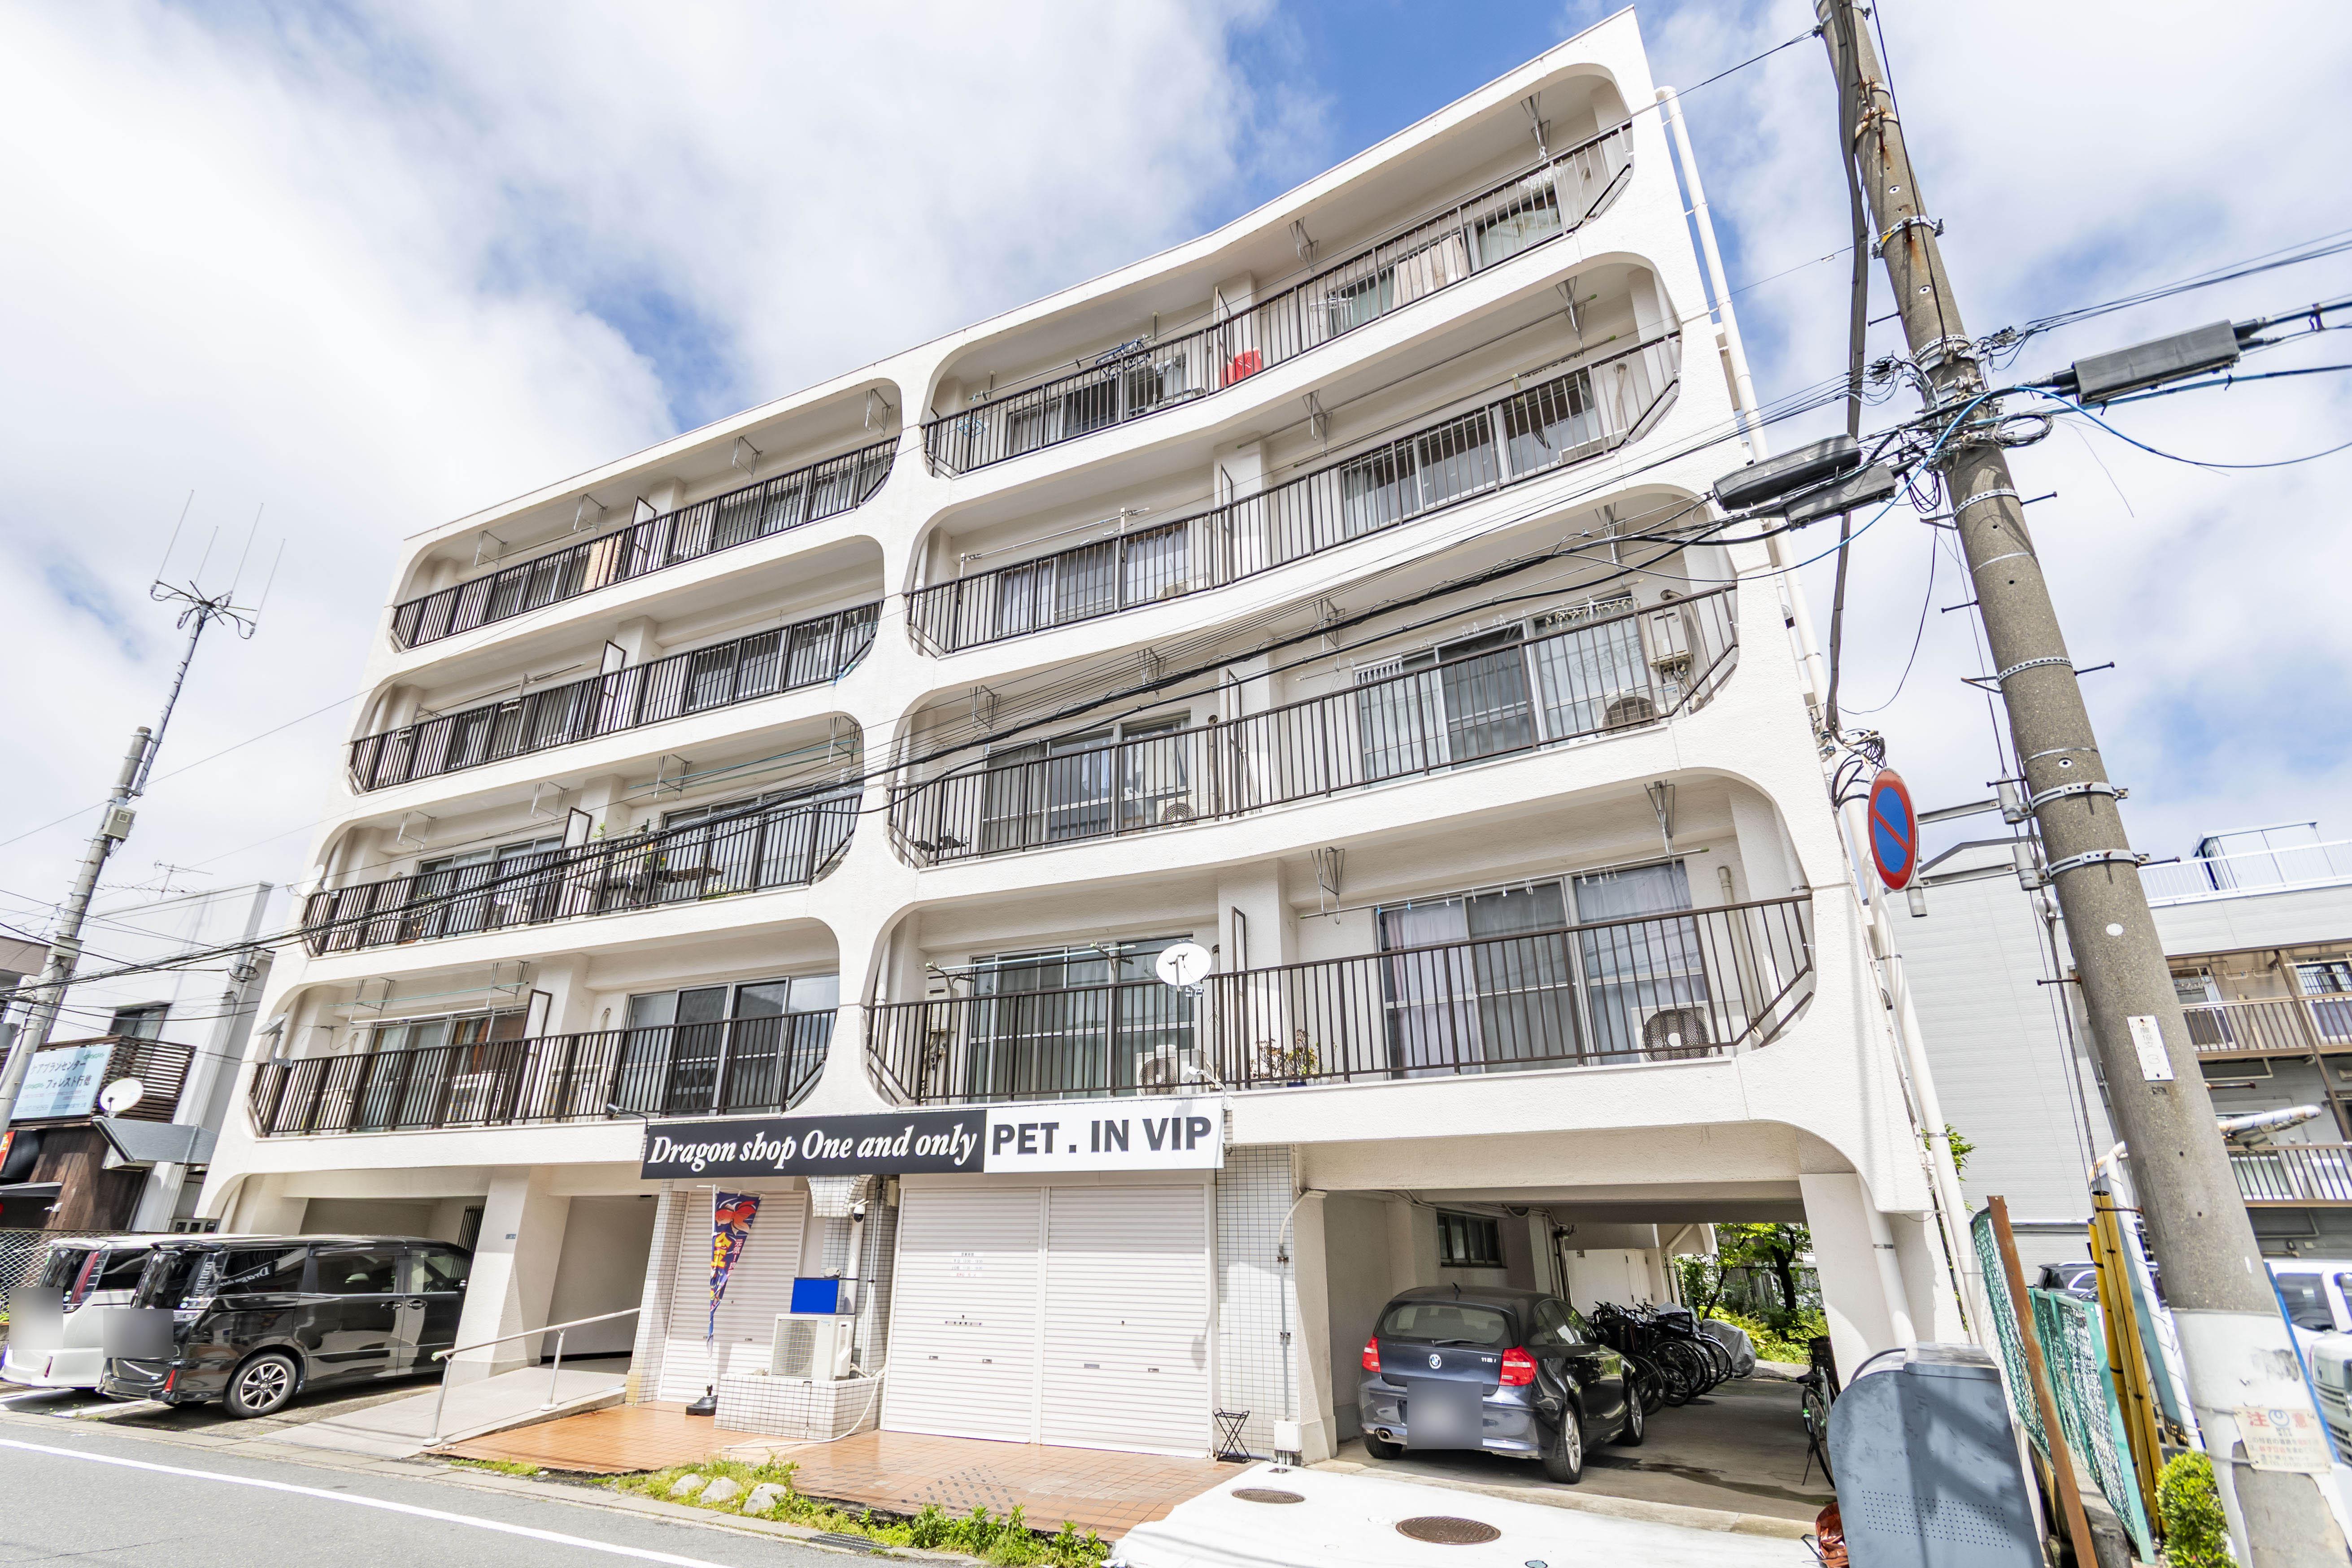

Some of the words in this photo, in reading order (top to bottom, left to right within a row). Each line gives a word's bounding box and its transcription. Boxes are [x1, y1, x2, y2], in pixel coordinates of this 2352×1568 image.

[647, 1136, 736, 1172] Dragon
[739, 1131, 796, 1169] shop
[801, 1130, 853, 1159] One
[857, 1125, 914, 1158] and
[915, 1123, 978, 1166] only
[992, 1122, 1059, 1155] PET
[1091, 1119, 1129, 1153] IN
[1142, 1116, 1211, 1151] VIP
[2246, 1411, 2270, 1427] 注
